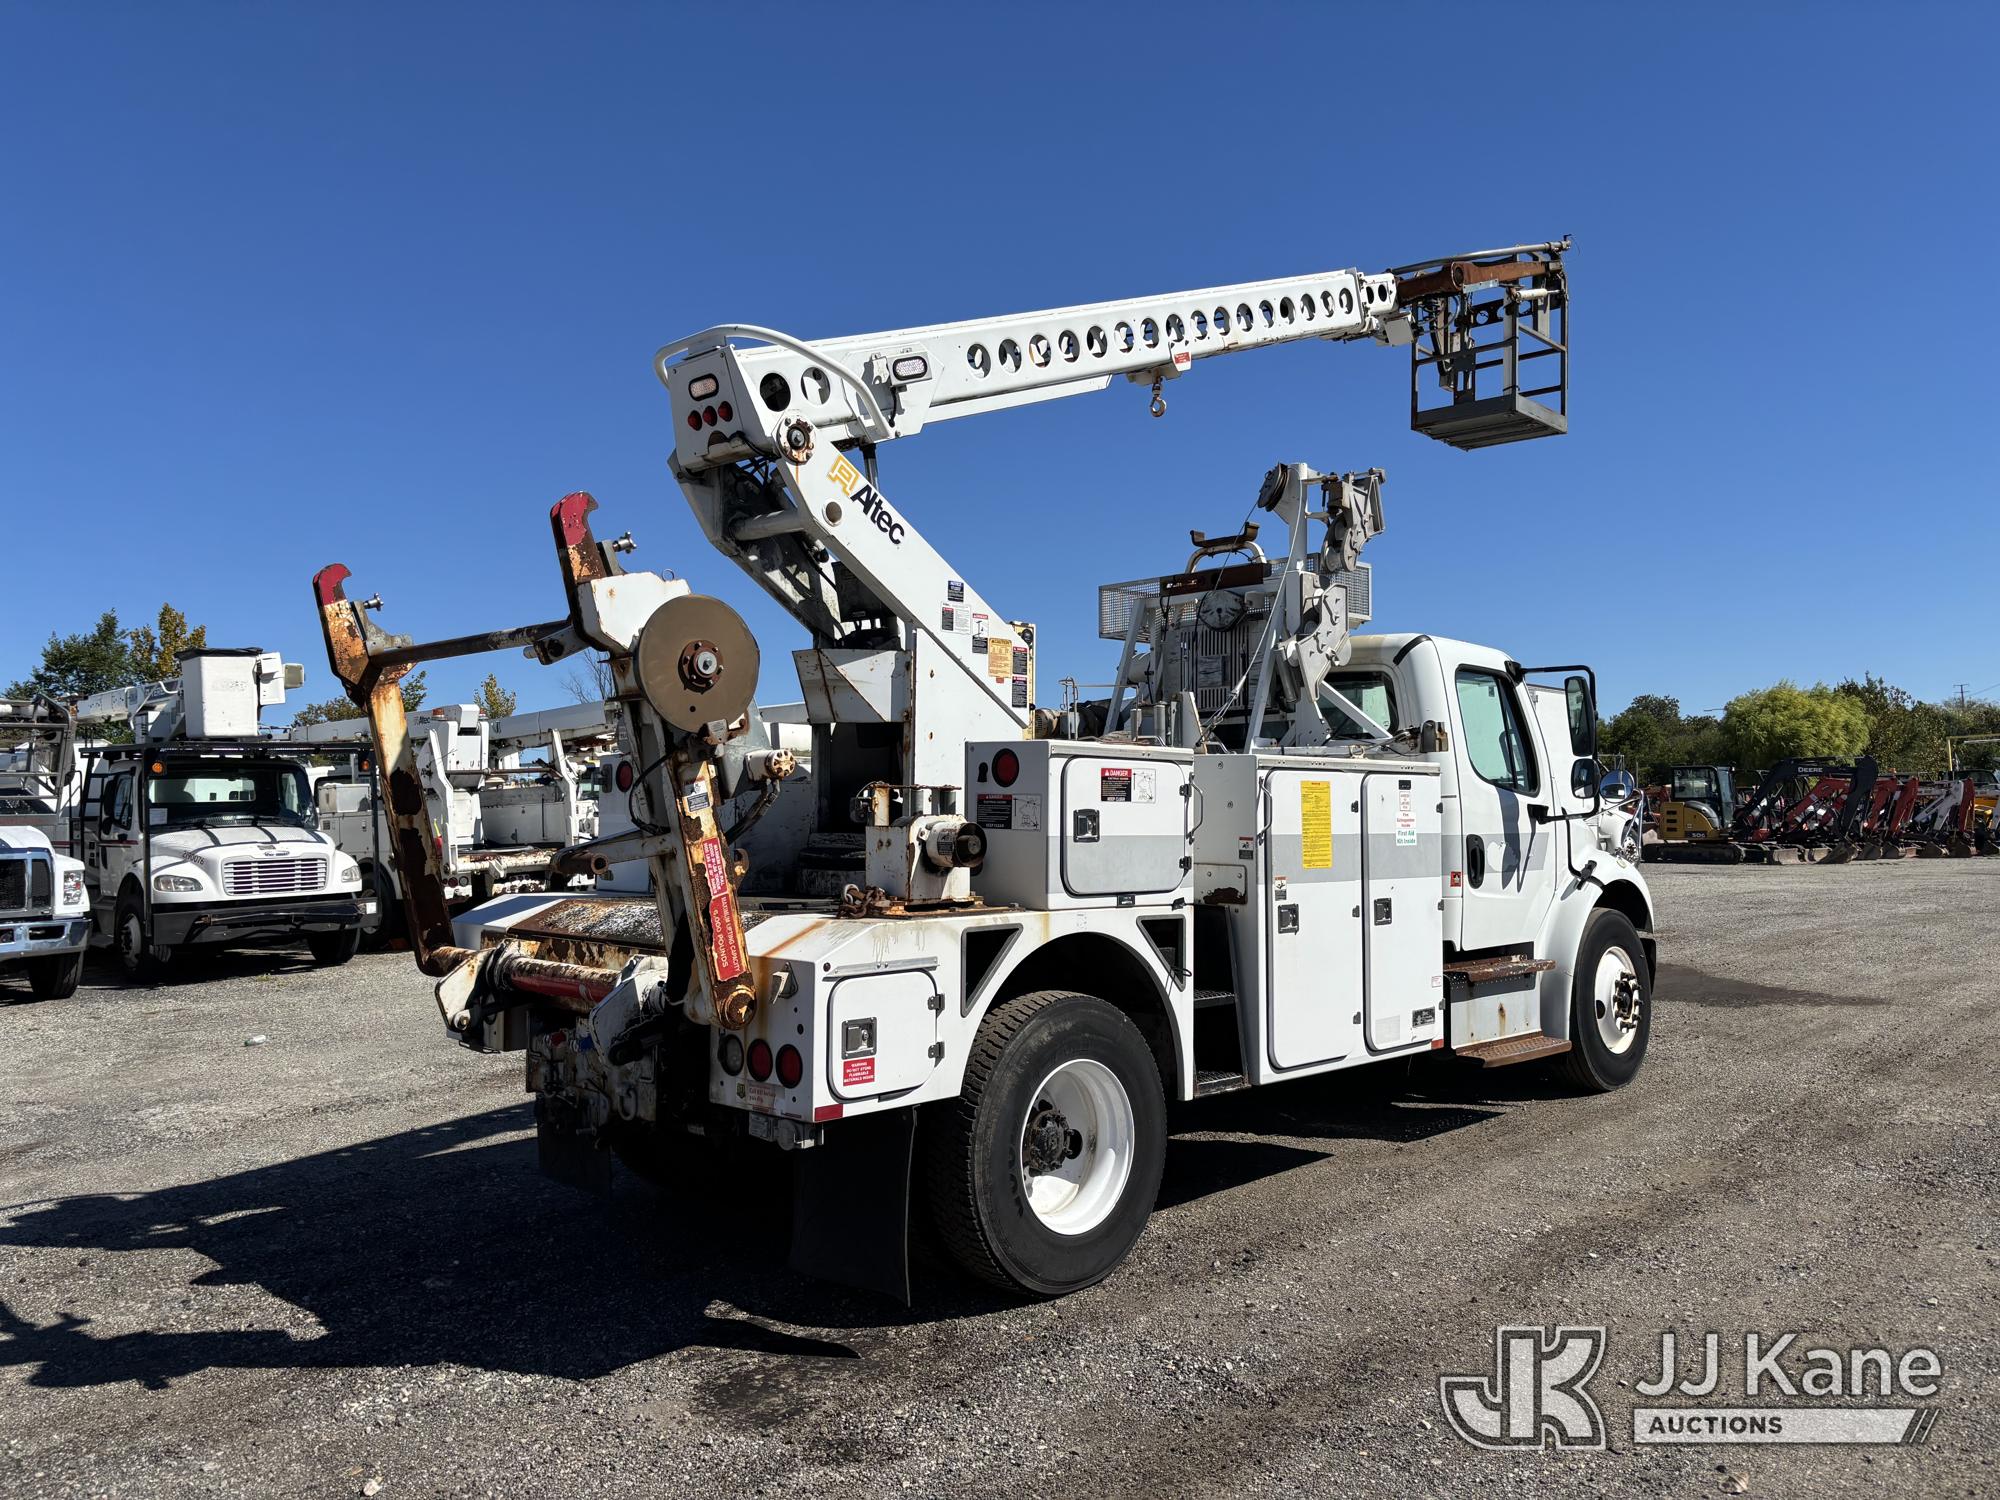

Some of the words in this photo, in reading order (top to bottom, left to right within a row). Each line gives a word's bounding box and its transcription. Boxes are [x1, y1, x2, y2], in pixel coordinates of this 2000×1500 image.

[850, 484, 904, 544] Altec
[1110, 769, 1129, 777] DANGER
[721, 896, 730, 923] MAXIMUM
[725, 922, 734, 945] LIFTING
[717, 934, 728, 967] POUNDS
[729, 945, 740, 972] CAPACITY
